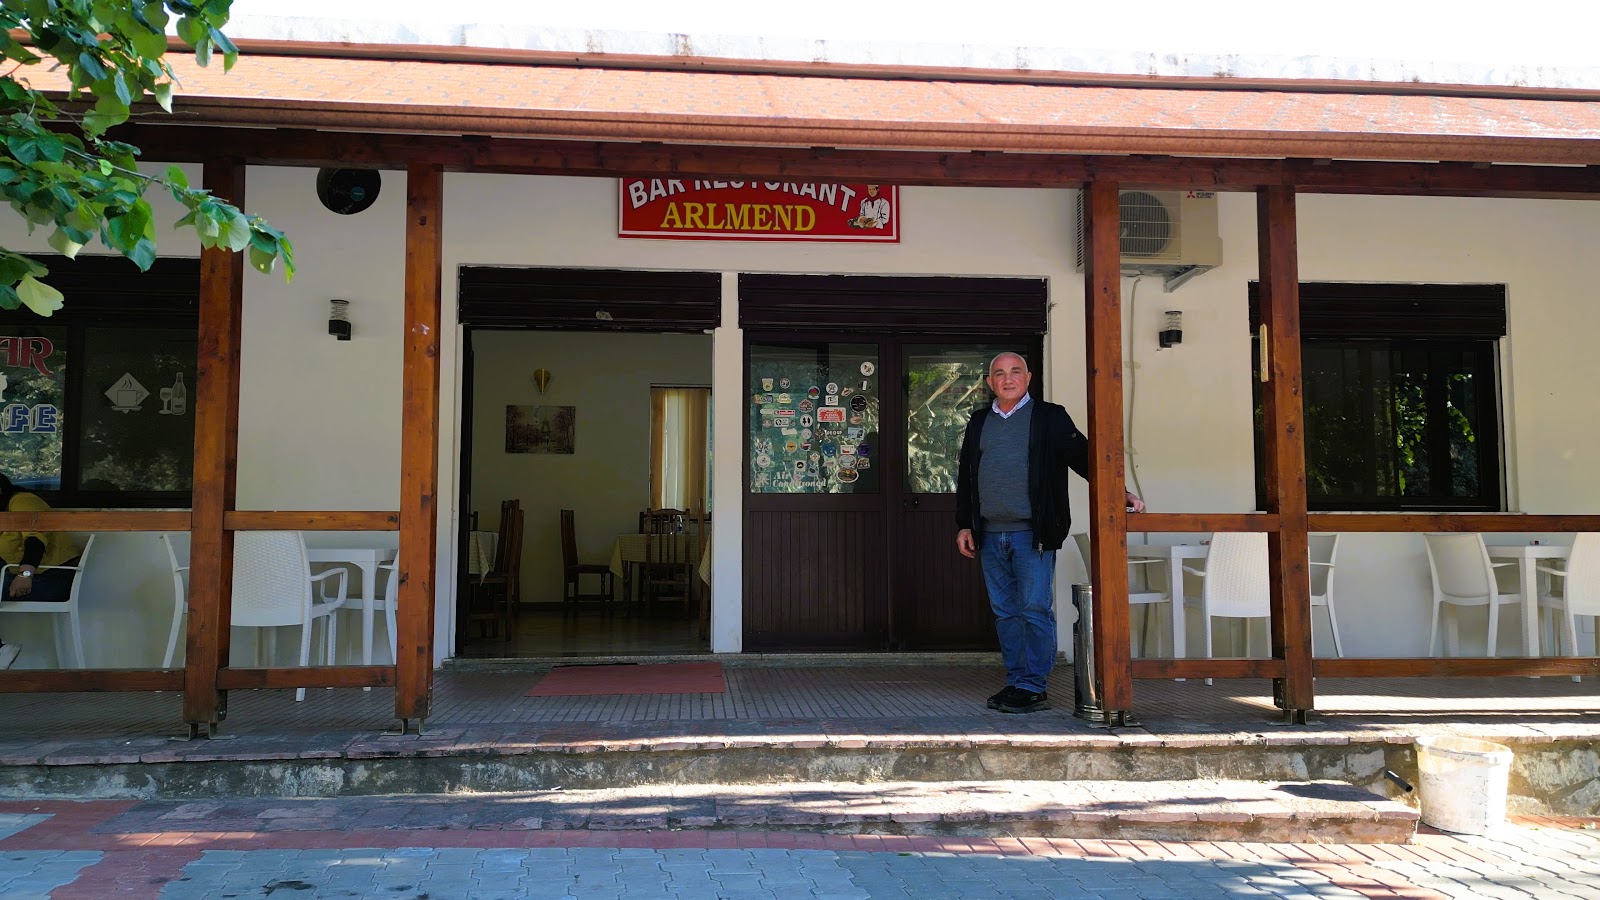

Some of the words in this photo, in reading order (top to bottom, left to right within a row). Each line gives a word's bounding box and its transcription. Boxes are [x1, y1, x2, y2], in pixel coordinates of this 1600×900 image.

[628, 178, 686, 209] BAR
[694, 179, 857, 212] RRANT
[660, 201, 816, 232] ARLMEND
[0, 403, 57, 433] FE
[773, 471, 789, 480] Air
